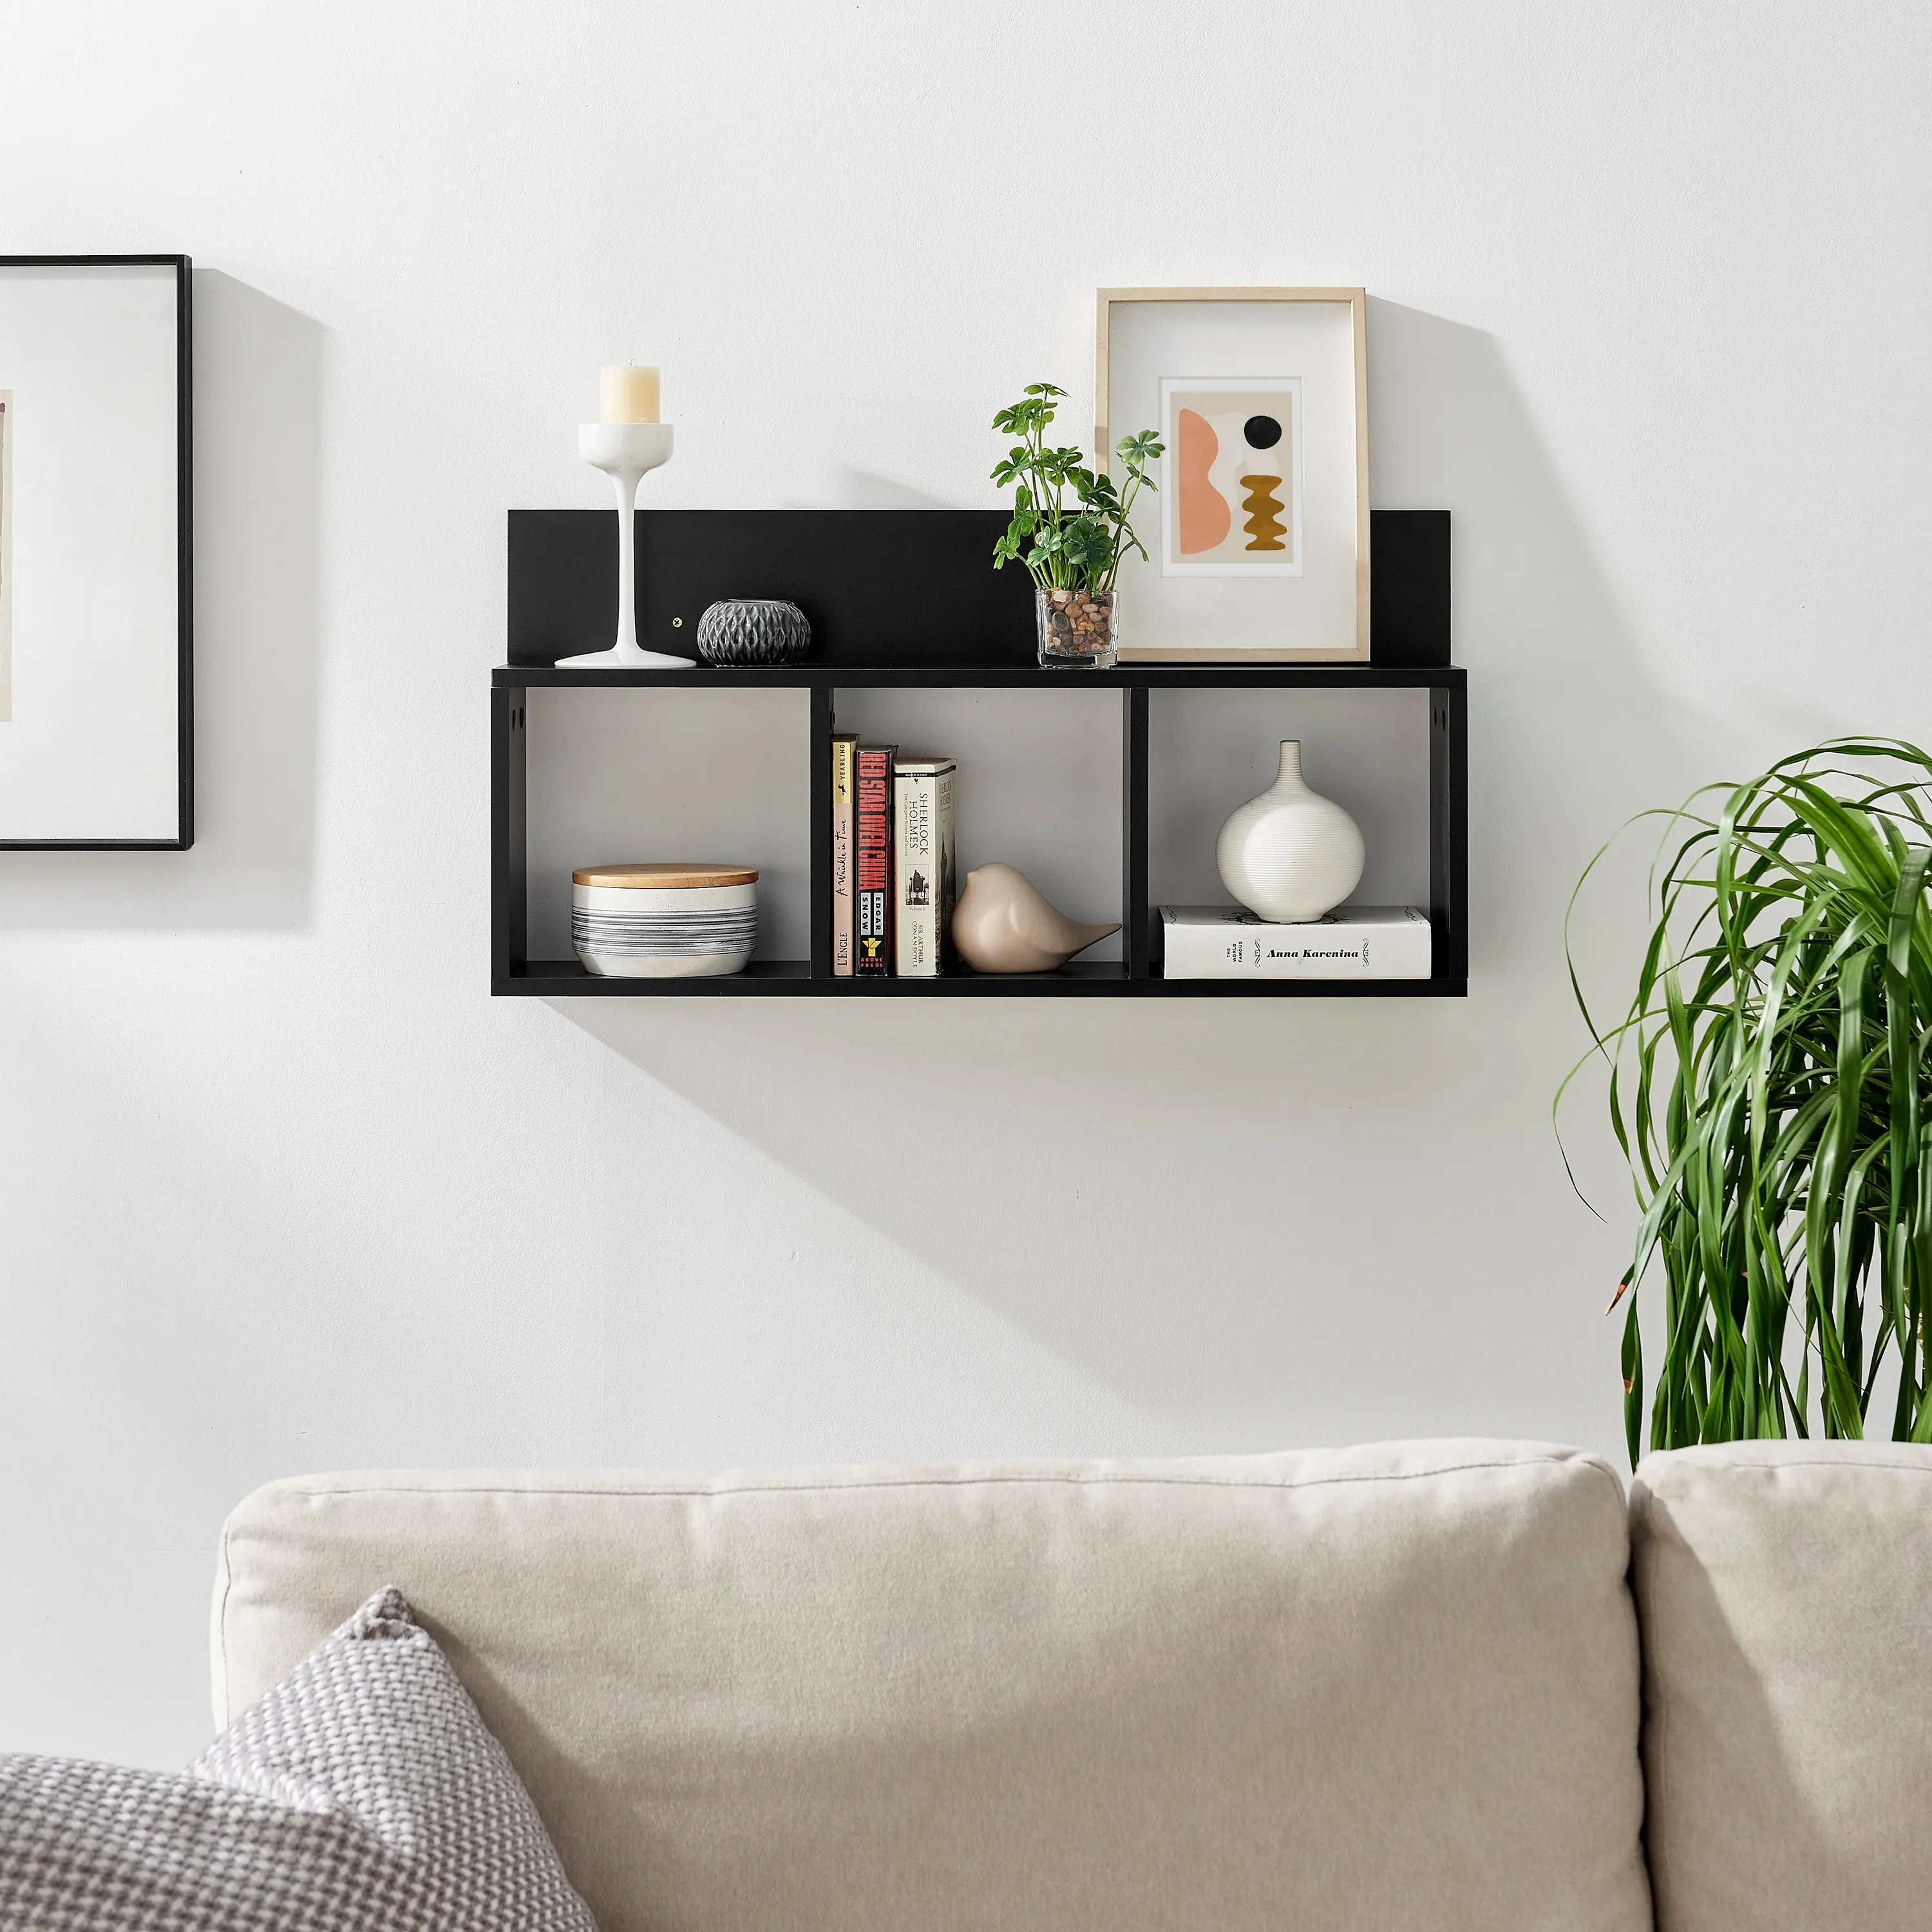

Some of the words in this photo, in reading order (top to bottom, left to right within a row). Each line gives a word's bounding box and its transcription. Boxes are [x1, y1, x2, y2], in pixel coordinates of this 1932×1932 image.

[858, 753, 886, 777] RED
[858, 780, 886, 811] STAR
[835, 819, 848, 840] Time
[858, 815, 886, 847] OVER
[909, 801, 918, 848] HOLMES
[919, 793, 929, 855] SHERLOCK
[838, 842, 846, 851] in
[837, 852, 846, 886] Wrinkle
[858, 849, 886, 891] CHINA
[835, 887, 848, 896] A
[837, 933, 848, 966] L'ENGLE
[1267, 949, 1299, 958] Anna
[1302, 949, 1359, 958] Karenina
